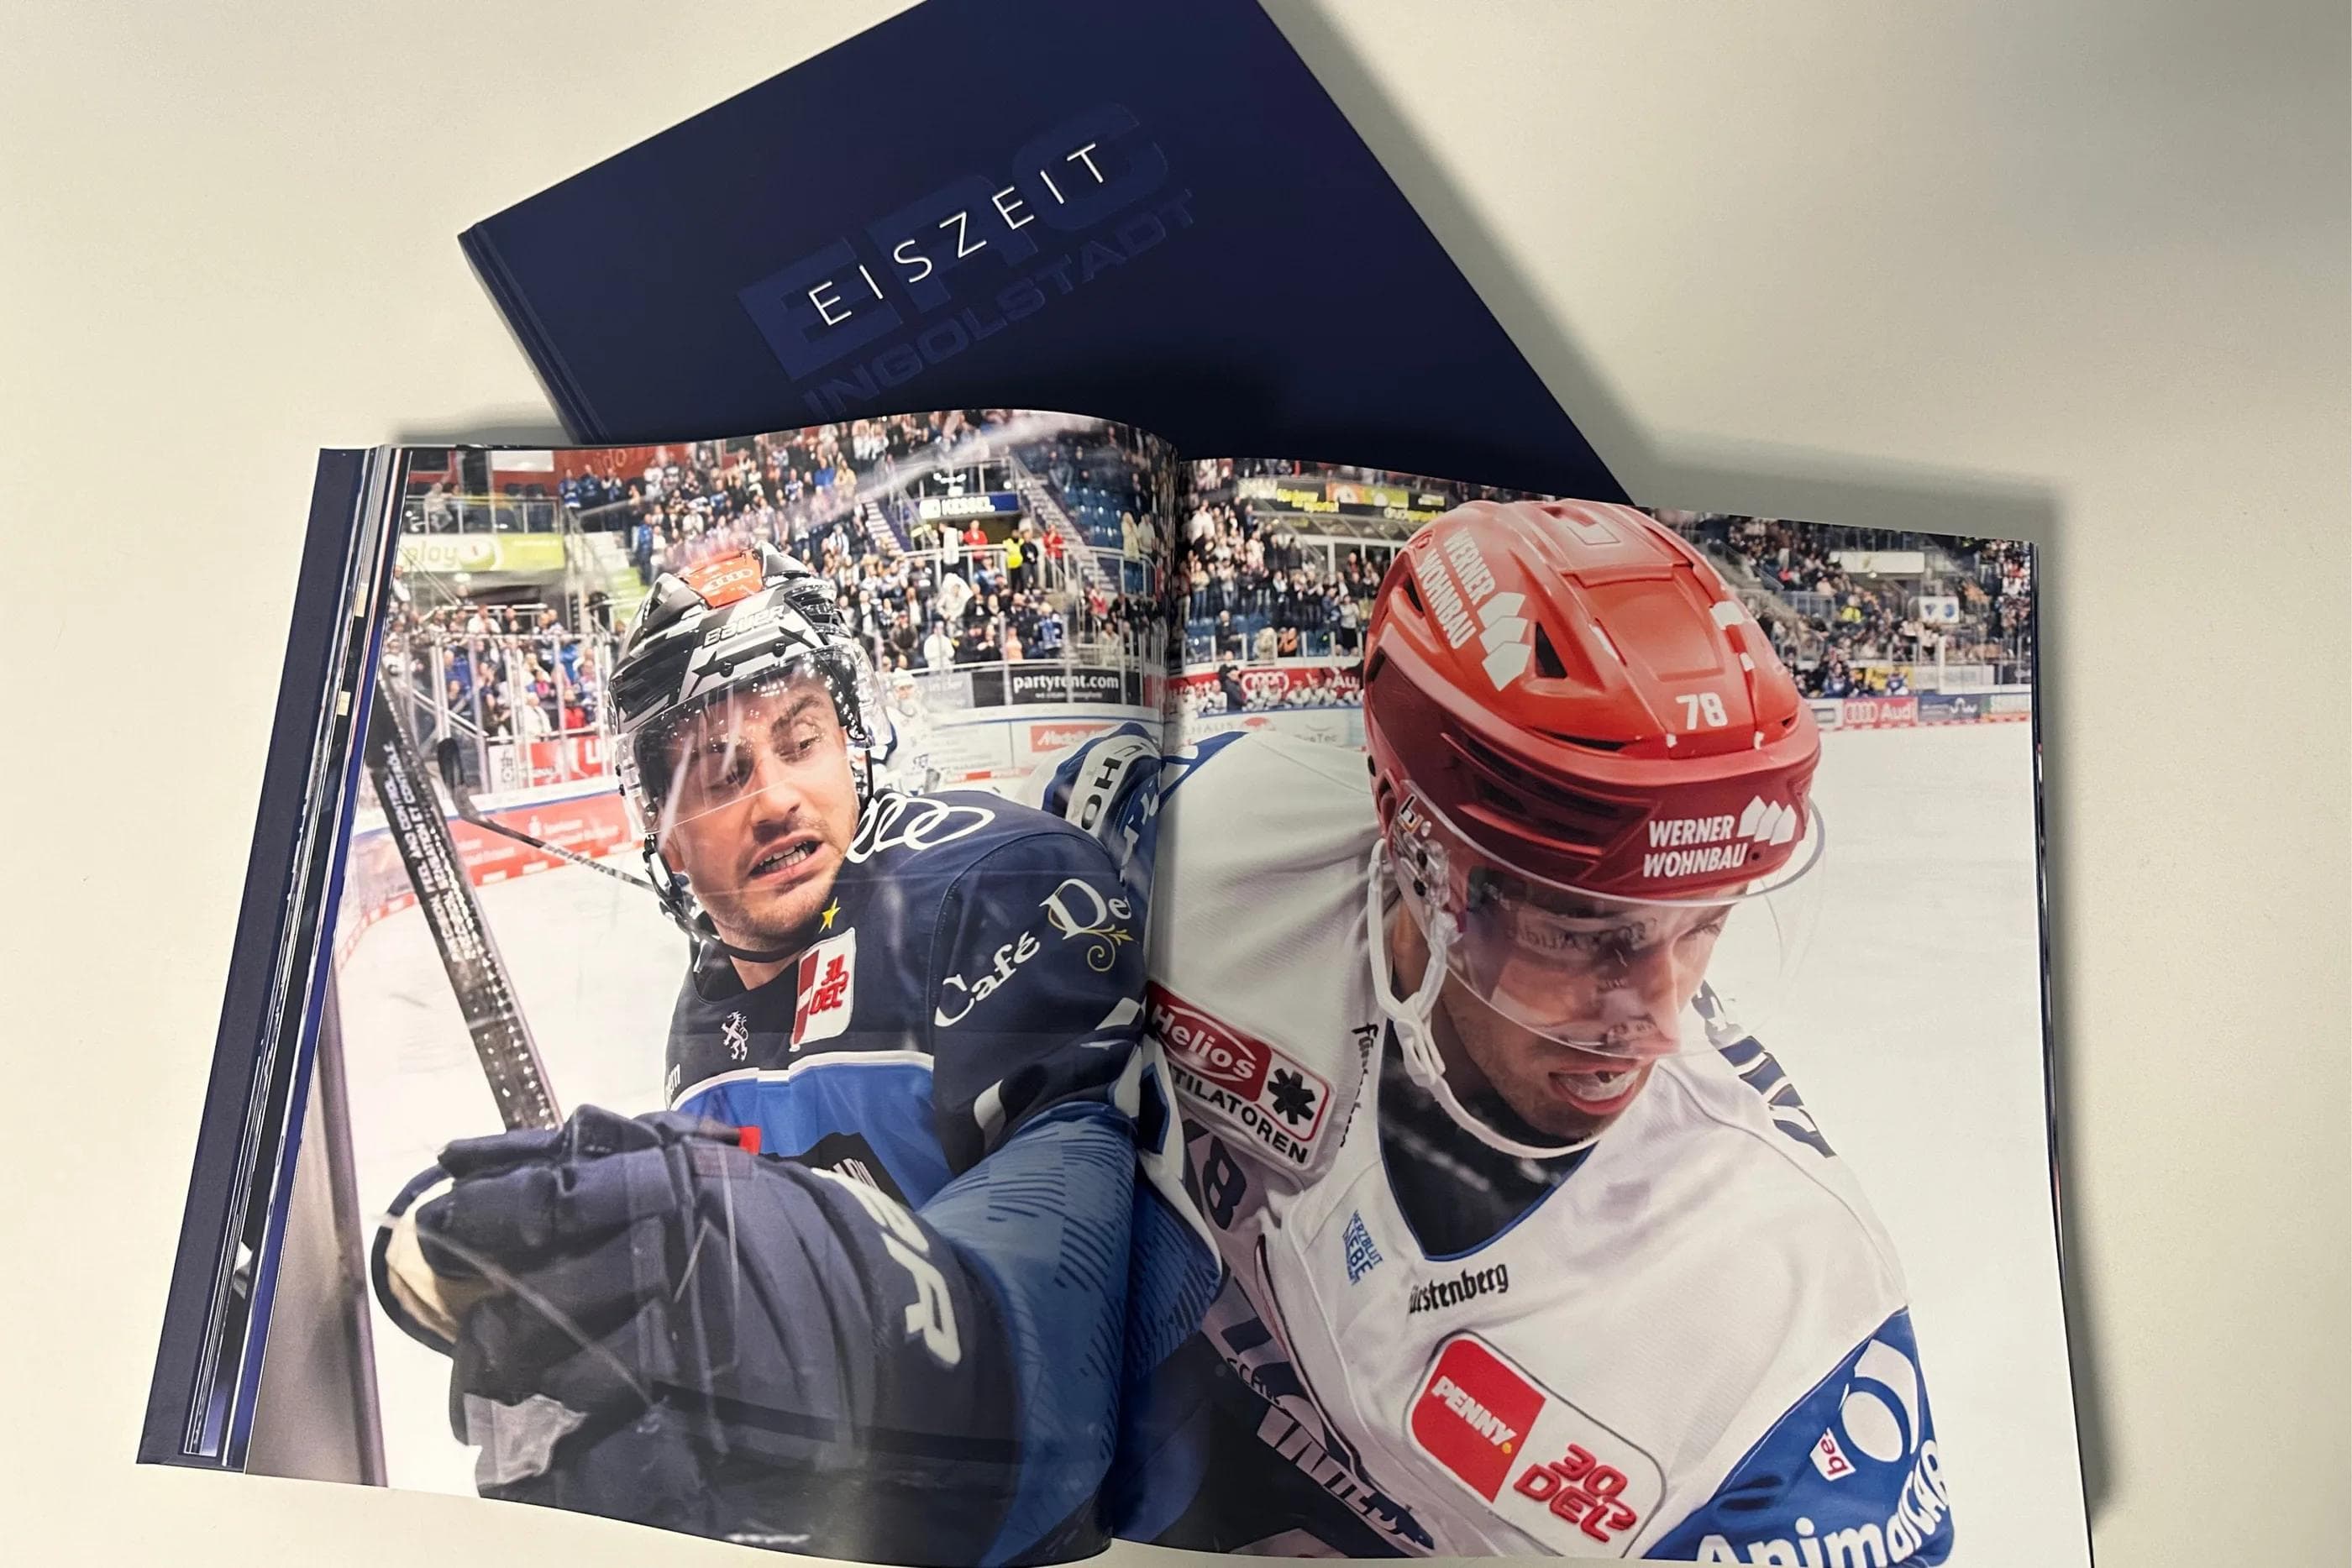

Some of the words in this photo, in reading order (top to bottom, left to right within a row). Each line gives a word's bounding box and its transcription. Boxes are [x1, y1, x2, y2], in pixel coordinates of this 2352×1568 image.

[736, 102, 1168, 383] ERC
[808, 142, 1105, 326] EISZEIT
[1416, 548, 1477, 650] WOHNBAU
[1444, 527, 1496, 606] WERNER
[1676, 692, 1728, 730] 78
[1642, 842, 1748, 878] WOHNBAU
[1648, 815, 1735, 847] WERNER
[934, 931, 1041, 1027] Café
[1152, 1004, 1257, 1079] Helios
[1168, 1062, 1309, 1164] TILATOREN
[1409, 1264, 1509, 1314] ürstenberg
[1548, 1444, 1628, 1498] 30
